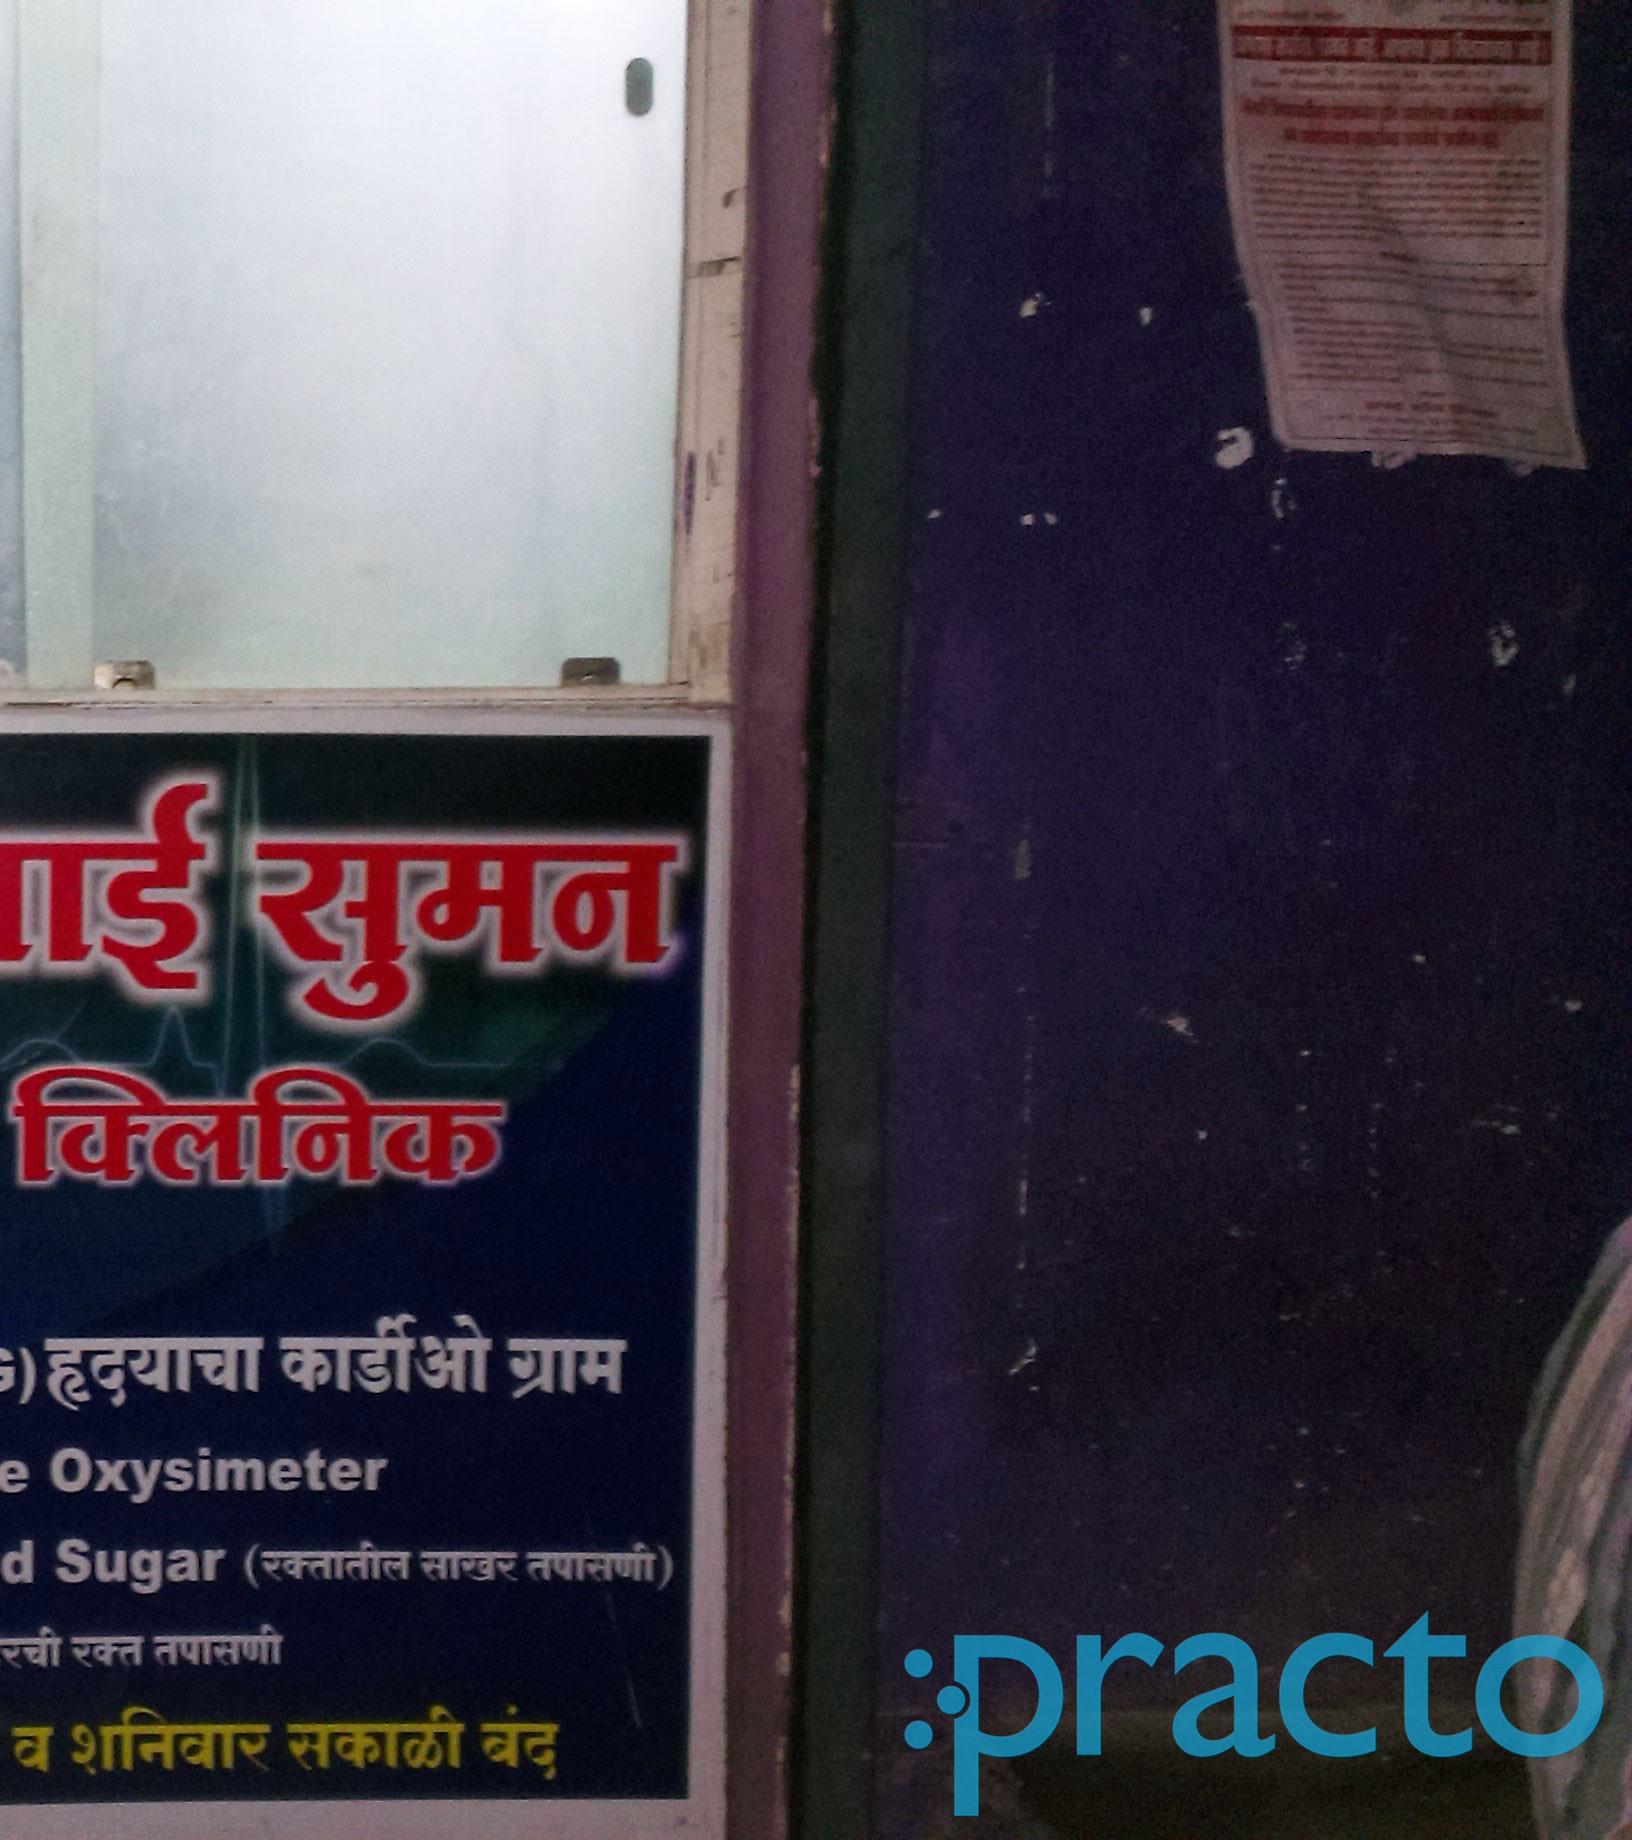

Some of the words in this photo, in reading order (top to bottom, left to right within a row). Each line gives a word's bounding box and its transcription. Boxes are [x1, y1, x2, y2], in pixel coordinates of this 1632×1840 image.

[252, 840, 681, 1023] सुमन
[10, 1066, 506, 1185] क्लिनिक
[506, 1337, 629, 1400] ग्राम
[49, 1446, 390, 1504] Oxysimeter
[55, 1538, 228, 1597] Sugar
[242, 1541, 412, 1590] (रक्तातील
[419, 1549, 519, 1583] साखर
[525, 1541, 675, 1592] तपासणी)
[69, 1634, 146, 1669] रक्त
[152, 1622, 284, 1668] तपासणी
[9, 1722, 55, 1774] व
[69, 1704, 273, 1777] शनिवार
[285, 1704, 468, 1774] सकाळी
